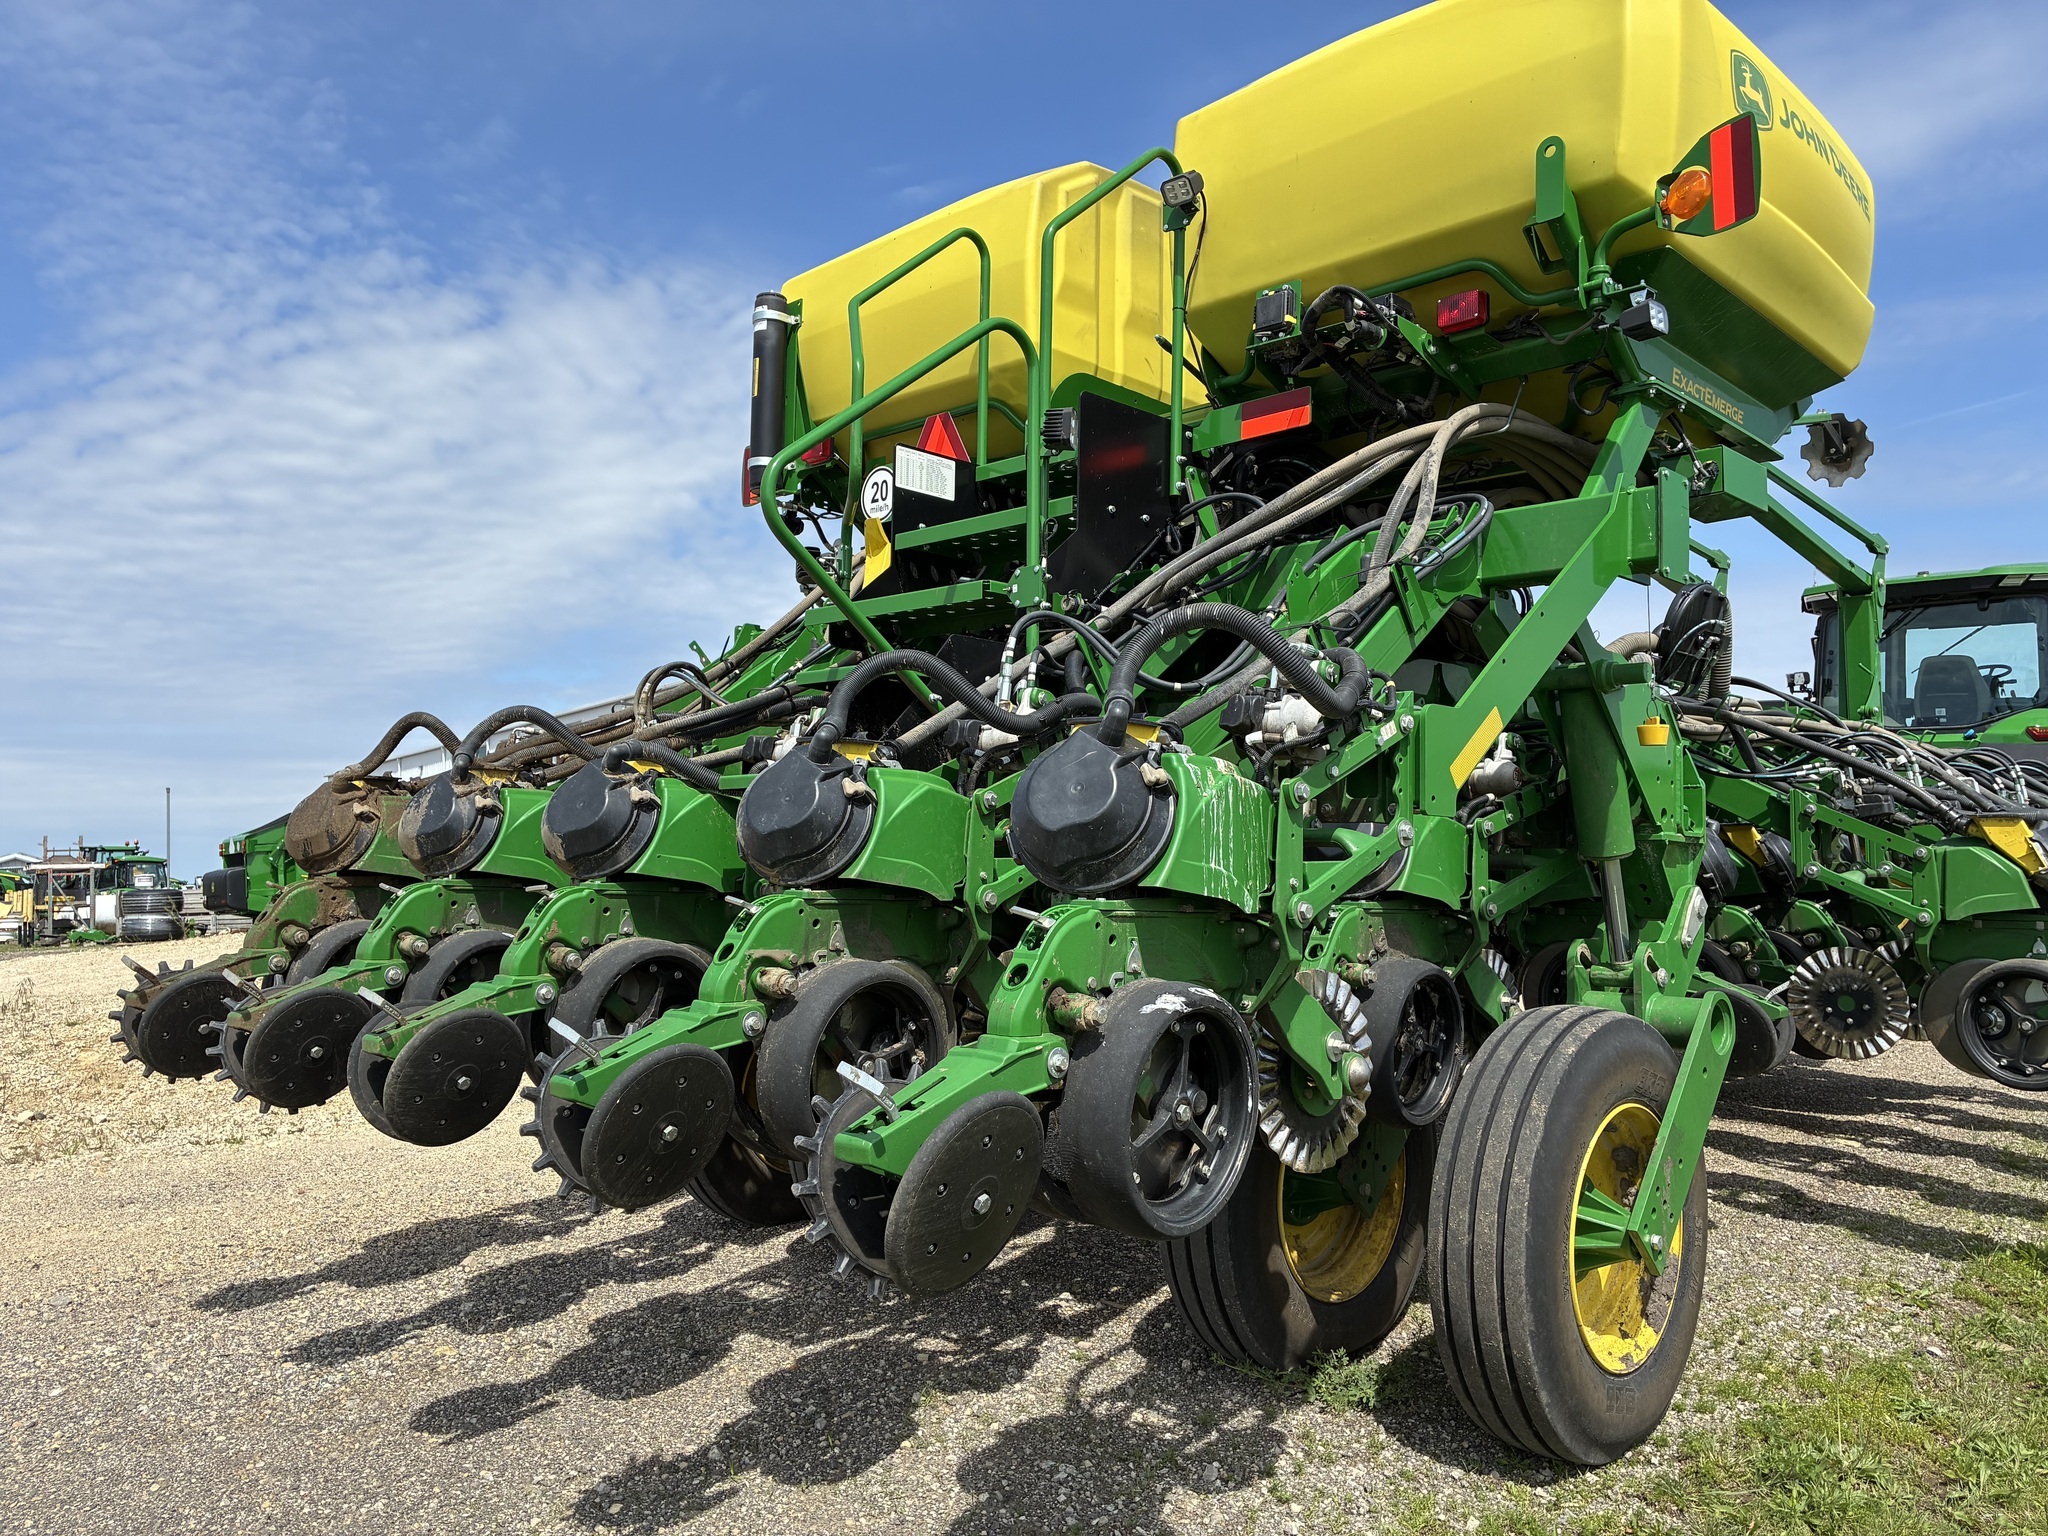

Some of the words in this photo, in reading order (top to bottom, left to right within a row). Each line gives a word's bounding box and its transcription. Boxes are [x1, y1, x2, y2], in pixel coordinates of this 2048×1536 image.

[1779, 98, 1830, 165] JOHN
[1828, 142, 1870, 222] DEERE
[1672, 367, 1744, 424] EXACTEMERGE
[871, 479, 888, 503] 20
